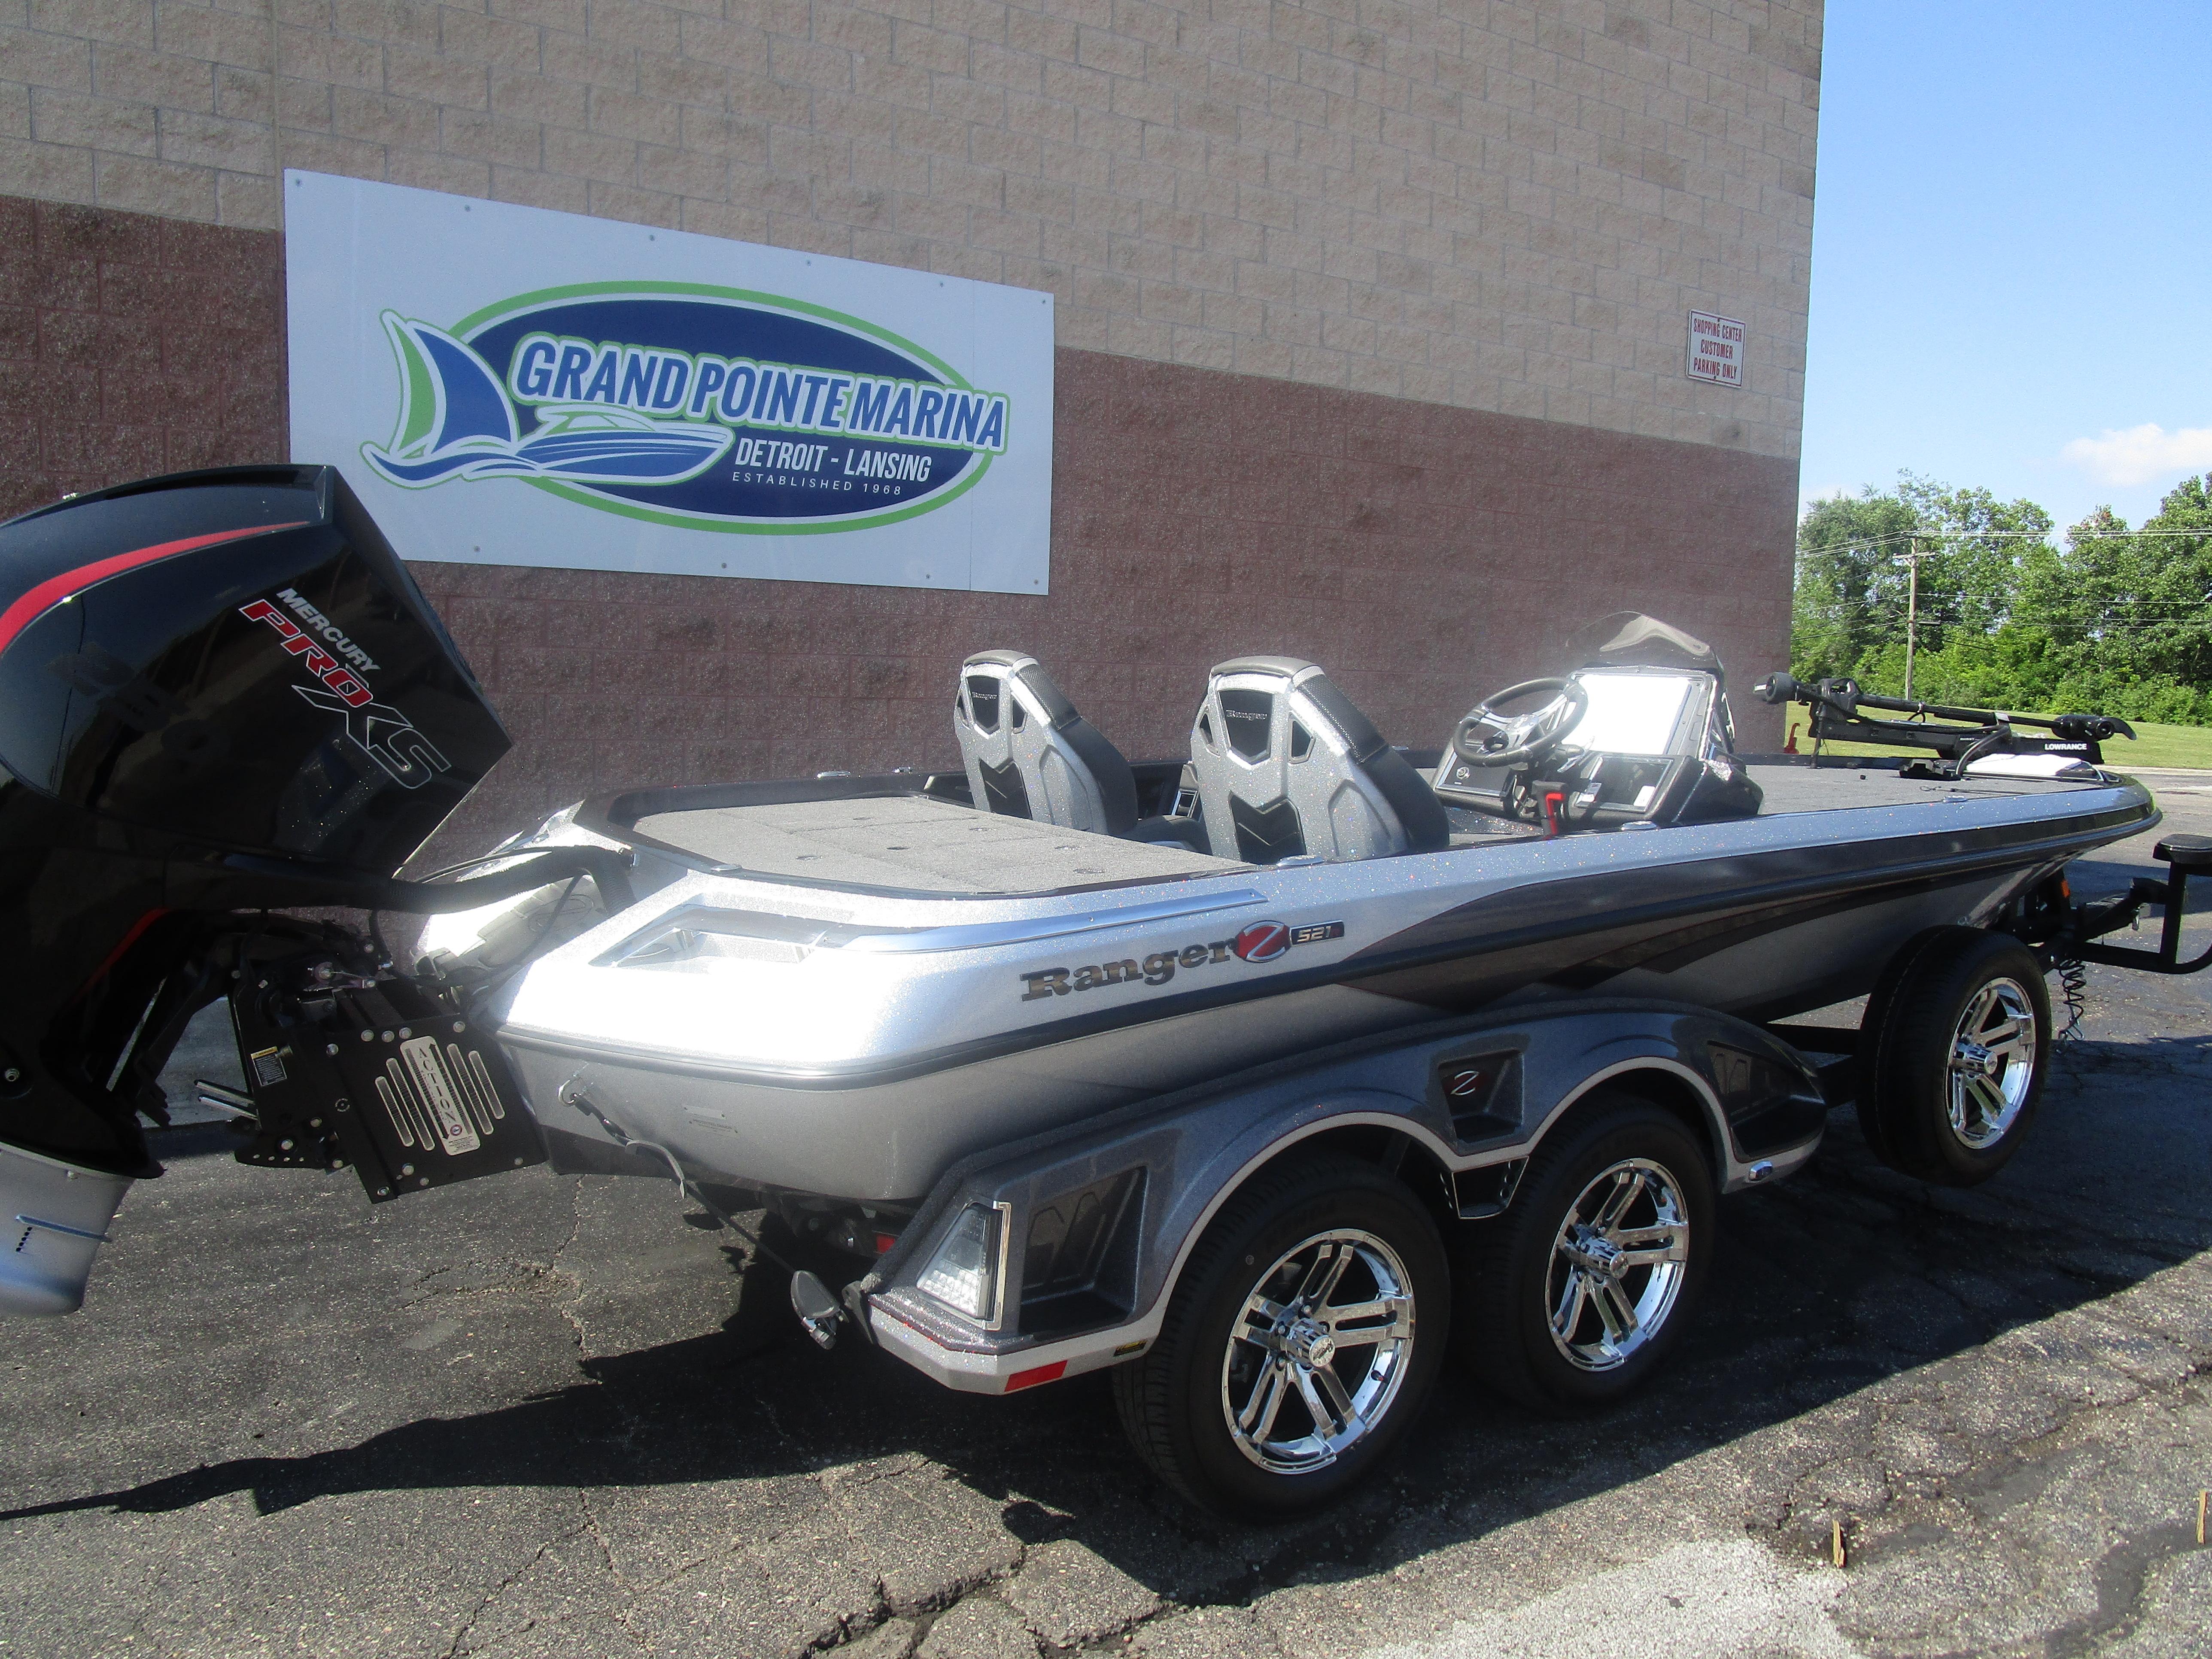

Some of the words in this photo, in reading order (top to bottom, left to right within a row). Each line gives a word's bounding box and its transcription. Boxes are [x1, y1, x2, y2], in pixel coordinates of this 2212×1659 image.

[1693, 318, 1720, 337] SHOPPING
[1722, 325, 1742, 342] CENTER
[1701, 339, 1733, 359] CUSTOMER
[517, 341, 689, 409] GRAND
[691, 362, 851, 429] POINTE
[848, 382, 1004, 448] MARINA
[1694, 357, 1720, 376] PARKING
[1723, 363, 1738, 379] ONLY
[732, 471, 852, 491] ESTABLISHED
[862, 483, 902, 495] 1968
[735, 438, 828, 473] DETROIT
[844, 449, 932, 482] LANSING
[238, 599, 373, 708] PRO
[276, 587, 380, 672] MERCURY
[292, 663, 452, 789] XS
[1020, 937, 1238, 1001] Ranger
[1244, 920, 1285, 963] Z
[419, 1047, 456, 1122] ACTION
